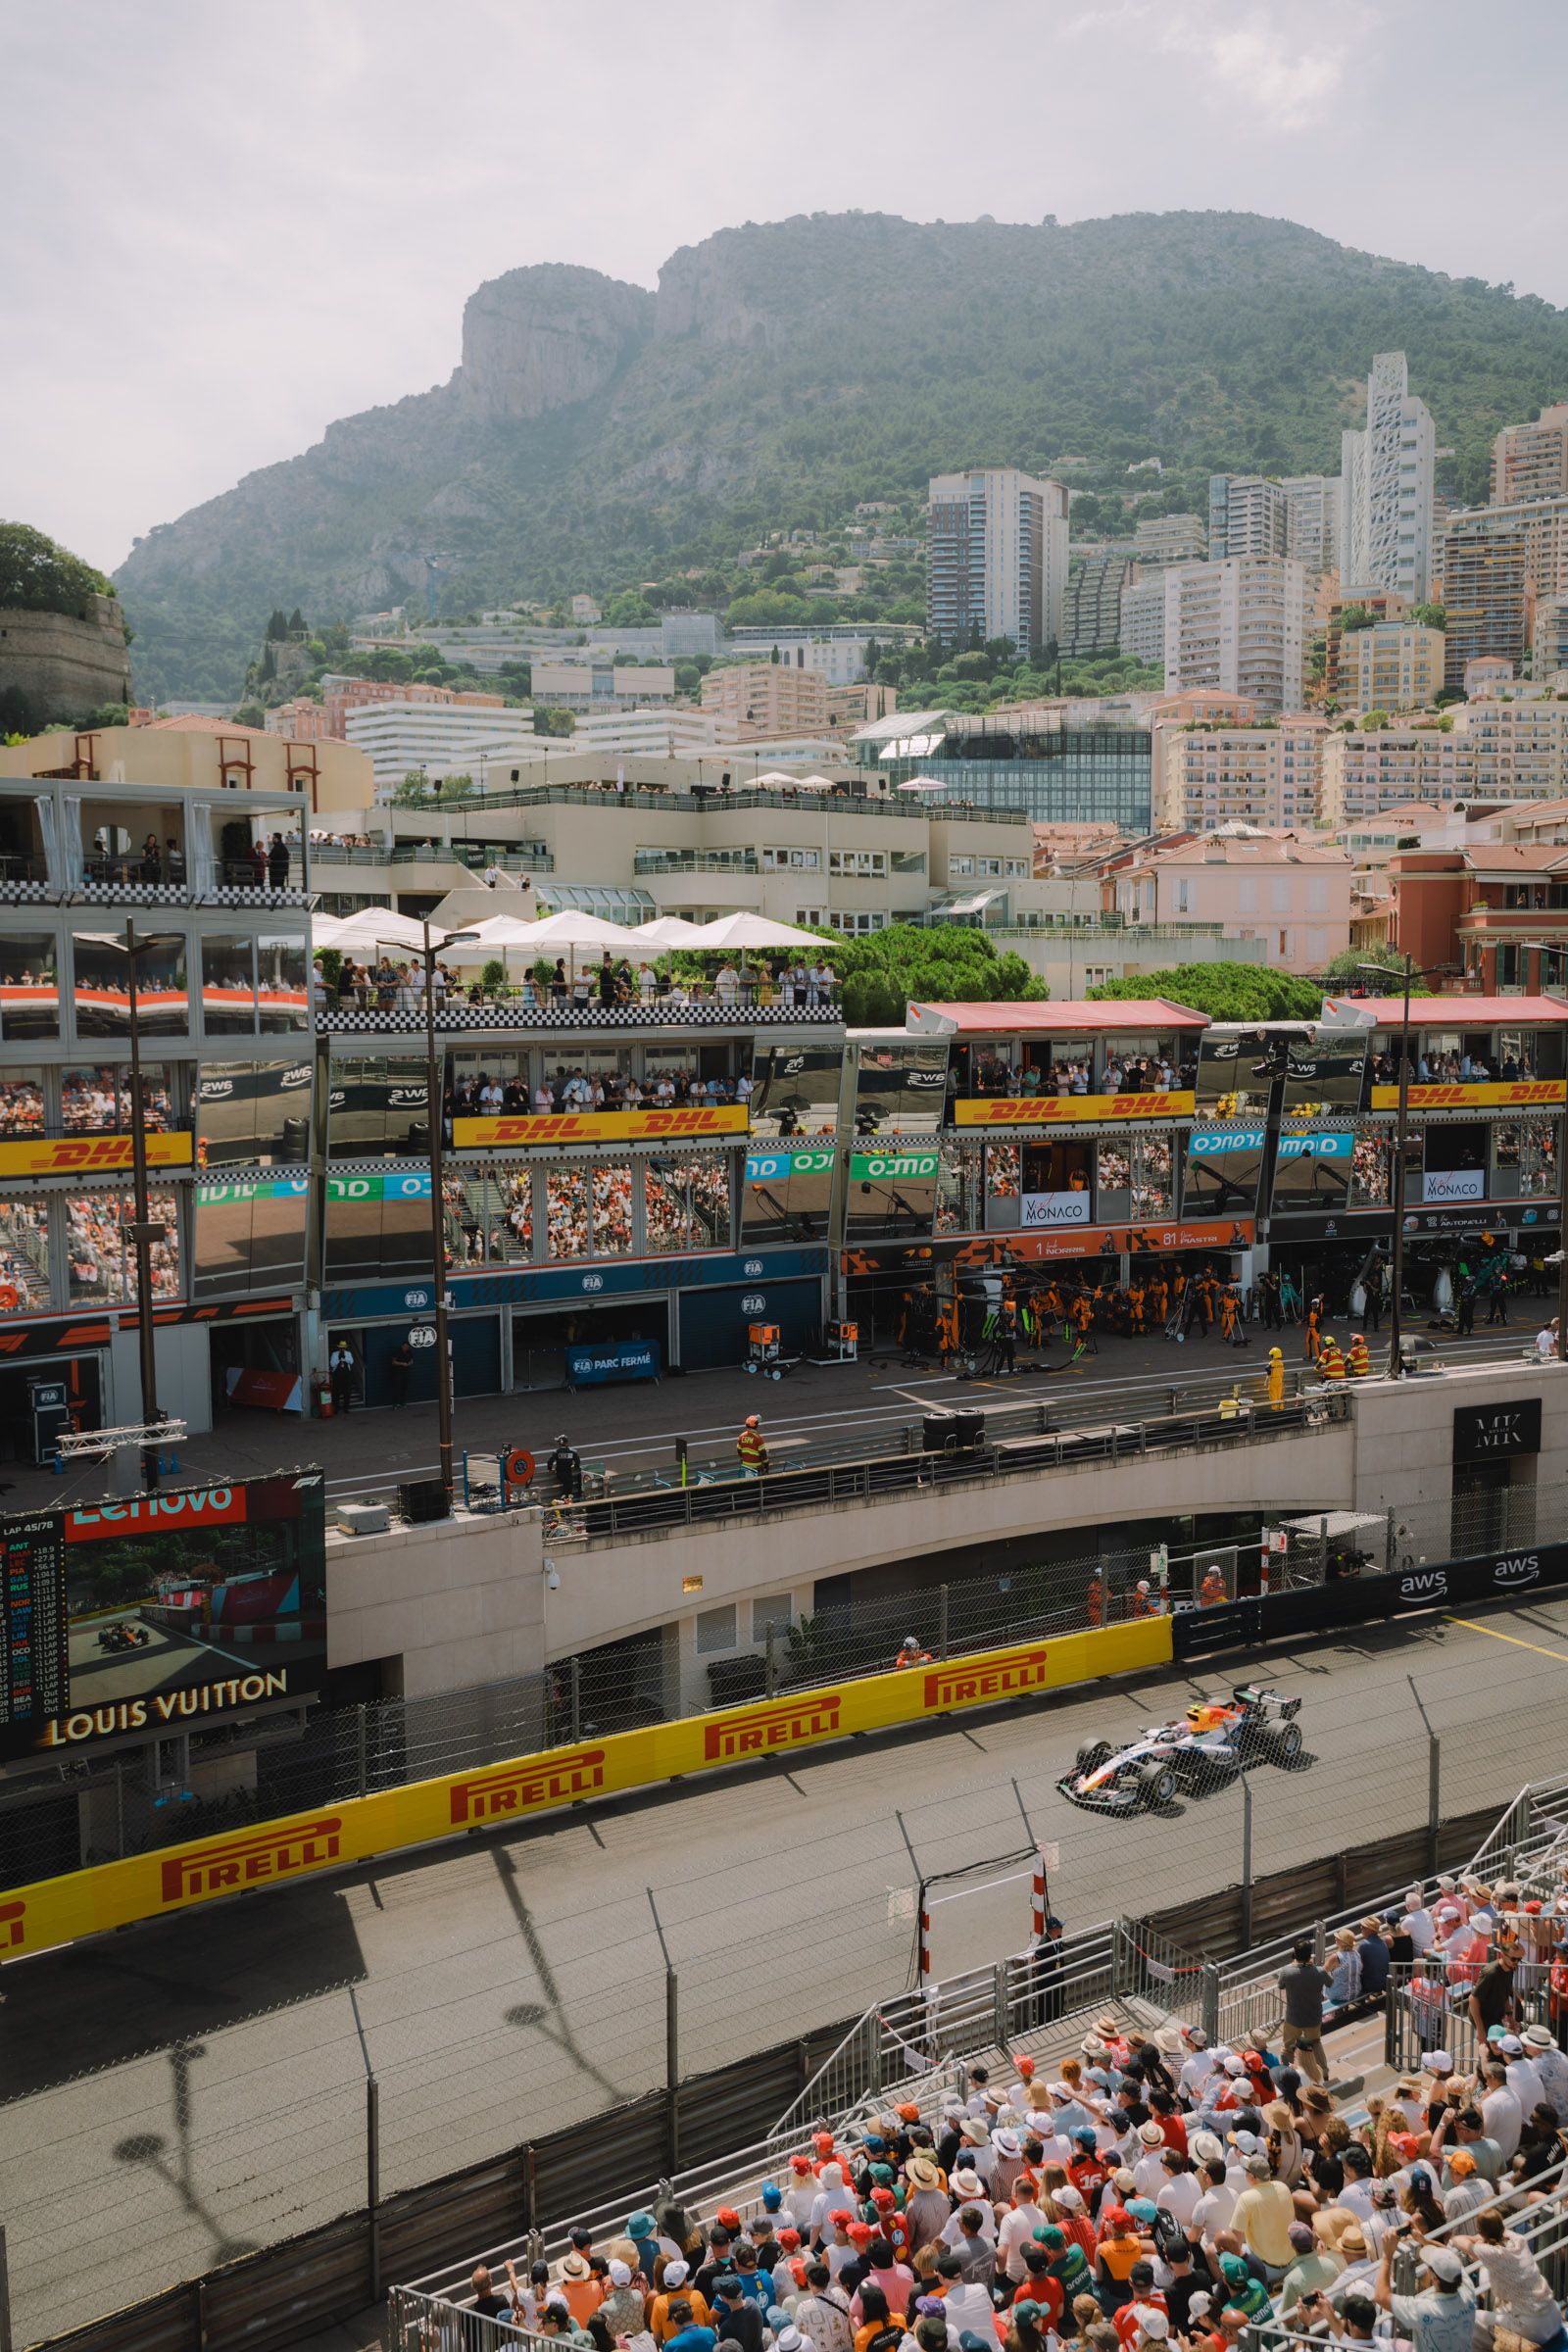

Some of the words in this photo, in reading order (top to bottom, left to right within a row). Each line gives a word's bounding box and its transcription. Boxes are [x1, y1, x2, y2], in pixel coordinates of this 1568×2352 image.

[1406, 1087, 1468, 1104] DHL
[1509, 1083, 1562, 1101] DHL
[988, 1101, 1063, 1120] DHL
[1111, 1096, 1171, 1114] DHL
[494, 1117, 584, 1141] DHL
[641, 1110, 720, 1133] DHL
[1427, 1184, 1477, 1199] MONACO
[1026, 1205, 1083, 1223] MONACO
[1163, 1232, 1176, 1246] 81
[1180, 1236, 1217, 1245] PIASTRI
[1036, 1243, 1042, 1255] 1
[1046, 1247, 1085, 1255] NORRIS
[594, 1358, 618, 1370] PARC
[620, 1351, 651, 1368] FERMÉ
[3, 1526, 22, 1536] LAP
[24, 1520, 54, 1532] 45/78
[9, 1542, 29, 1551] ANT
[9, 1558, 26, 1568] LEC
[1494, 1555, 1539, 1577] aws
[9, 1567, 25, 1576] PIA
[10, 1574, 29, 1584] GAS
[10, 1583, 29, 1592] RUS
[1400, 1571, 1446, 1592] aws
[11, 1598, 30, 1608] NOR
[11, 1606, 32, 1616] LAW
[43, 1601, 57, 1610] LAP
[12, 1632, 27, 1641] LIN
[12, 1640, 30, 1648] HUL
[12, 1646, 30, 1656] OCO
[44, 1642, 58, 1650] LAP
[12, 1655, 29, 1664] COL
[44, 1649, 58, 1658] LAP
[44, 1657, 58, 1666] LAP
[45, 1665, 59, 1674] LAP
[13, 1679, 31, 1689] PER
[45, 1673, 59, 1682] LAP
[924, 1650, 1047, 1708] PIRELLI
[13, 1694, 32, 1704] BEA
[14, 1702, 32, 1712] BOT
[44, 1697, 59, 1706] Out
[51, 1700, 148, 1745] LOUIS
[157, 1668, 287, 1719] VUITTON
[44, 1705, 59, 1714] Out
[704, 1695, 841, 1761] PIRELLI
[450, 1749, 605, 1825] PIRELLI
[162, 1817, 342, 1903] PIRELLI
[1080, 2175, 1102, 2189] 16
[893, 2230, 904, 2245] hp
[758, 2291, 768, 2309] hp
[1250, 2302, 1271, 2324] ramco
